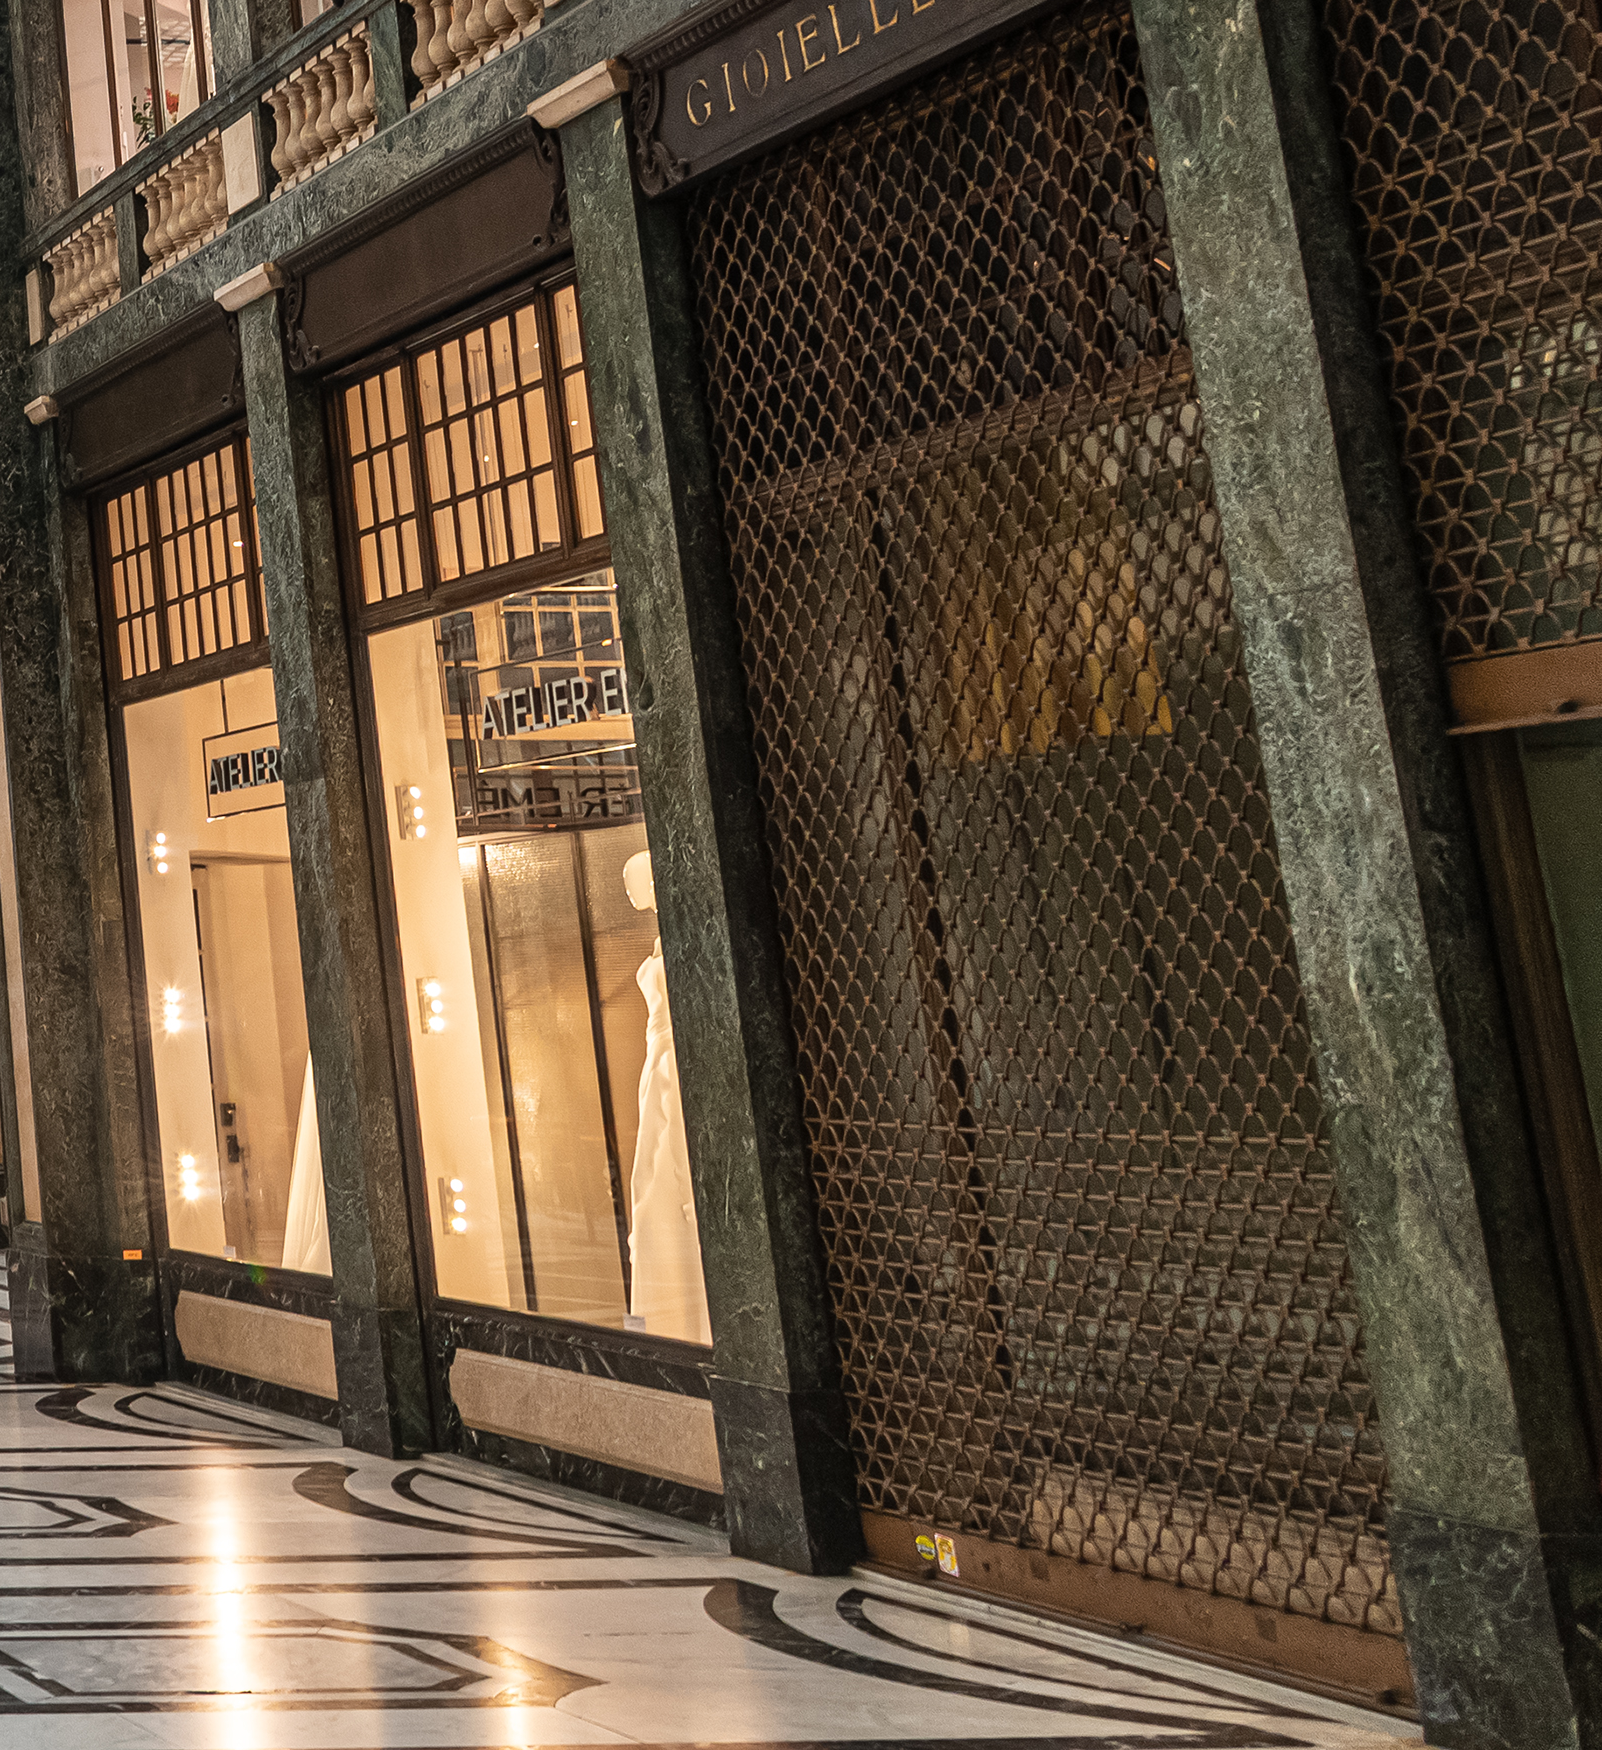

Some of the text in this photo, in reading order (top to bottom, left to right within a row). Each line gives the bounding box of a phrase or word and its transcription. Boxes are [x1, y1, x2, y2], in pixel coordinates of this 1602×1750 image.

[482, 668, 629, 740] ATELIER E
[209, 746, 281, 795] ATELIER
